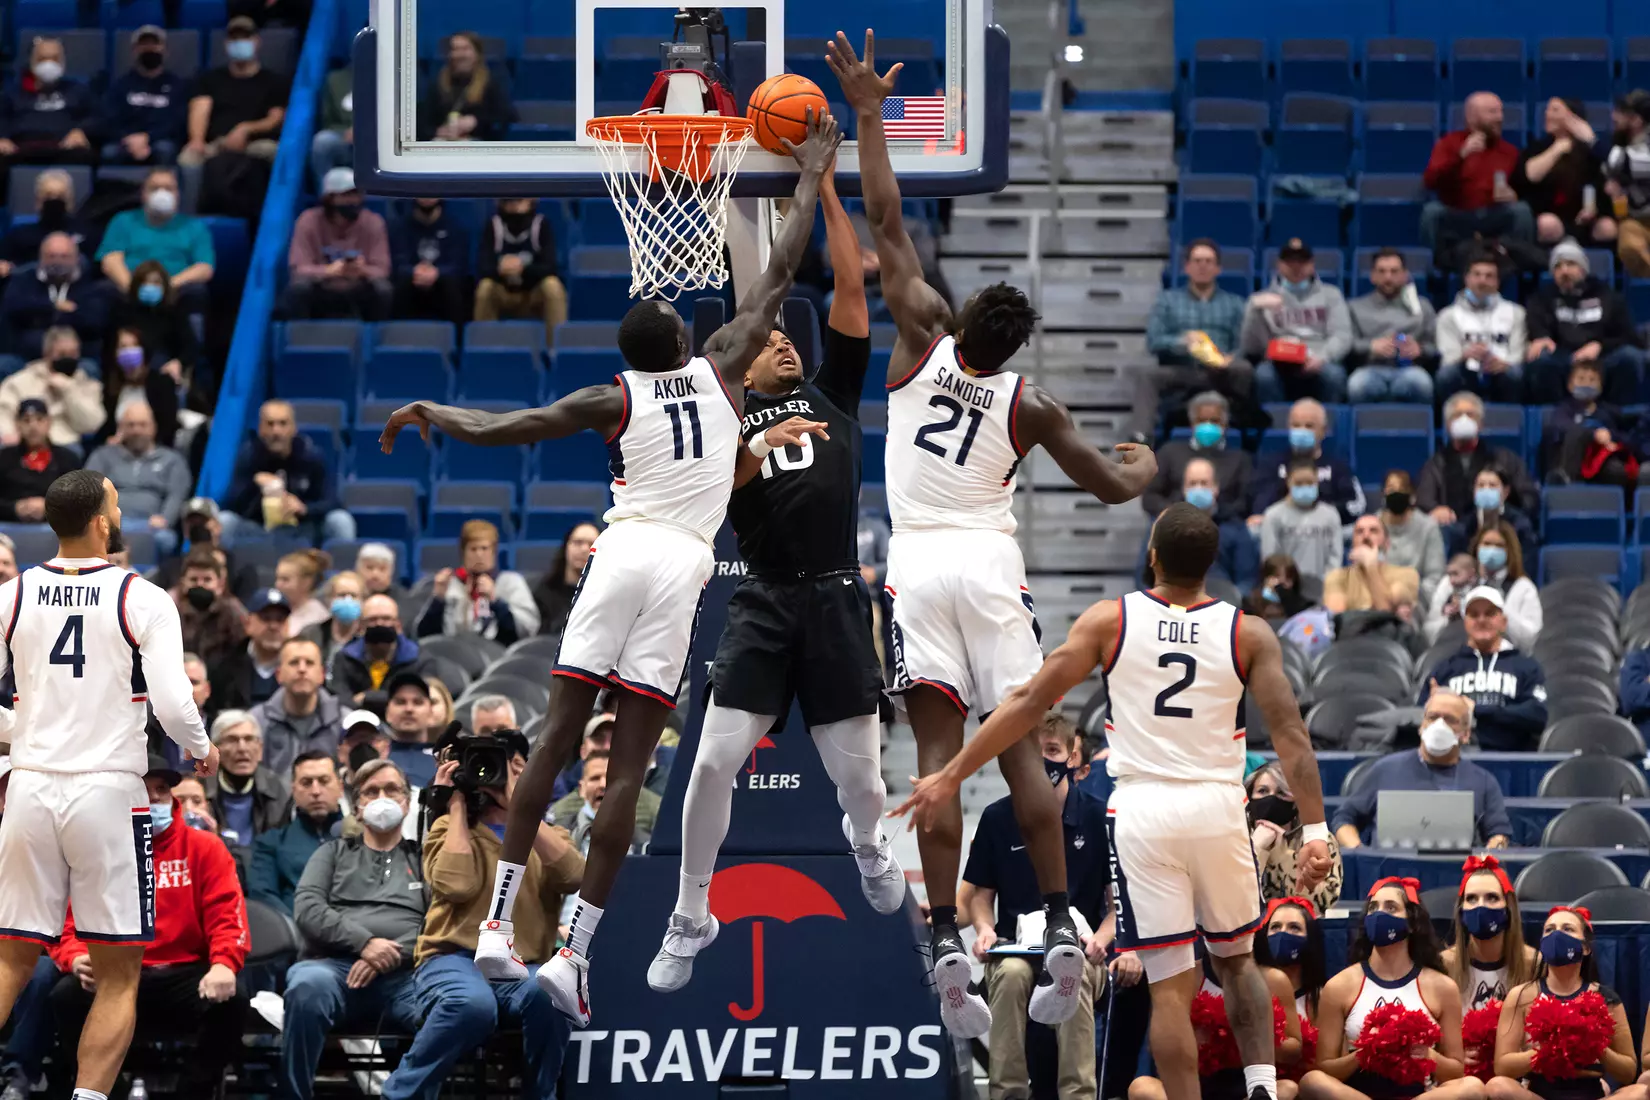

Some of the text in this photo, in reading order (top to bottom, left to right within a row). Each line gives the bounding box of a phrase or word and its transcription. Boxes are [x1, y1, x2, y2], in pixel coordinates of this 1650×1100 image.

[654, 375, 698, 399] AKOK
[933, 366, 995, 410] SANOGO
[663, 401, 703, 460] 11
[742, 399, 813, 435] BUTLER
[914, 395, 984, 466] 21
[38, 585, 100, 607] MARTIN
[49, 615, 86, 678] 4
[1157, 620, 1200, 644] COLE
[1154, 652, 1197, 718] 2
[1449, 670, 1518, 699] UCONN
[156, 868, 192, 889] ATE
[159, 857, 188, 873] CITY
[569, 1025, 942, 1084] TRAVELERS
